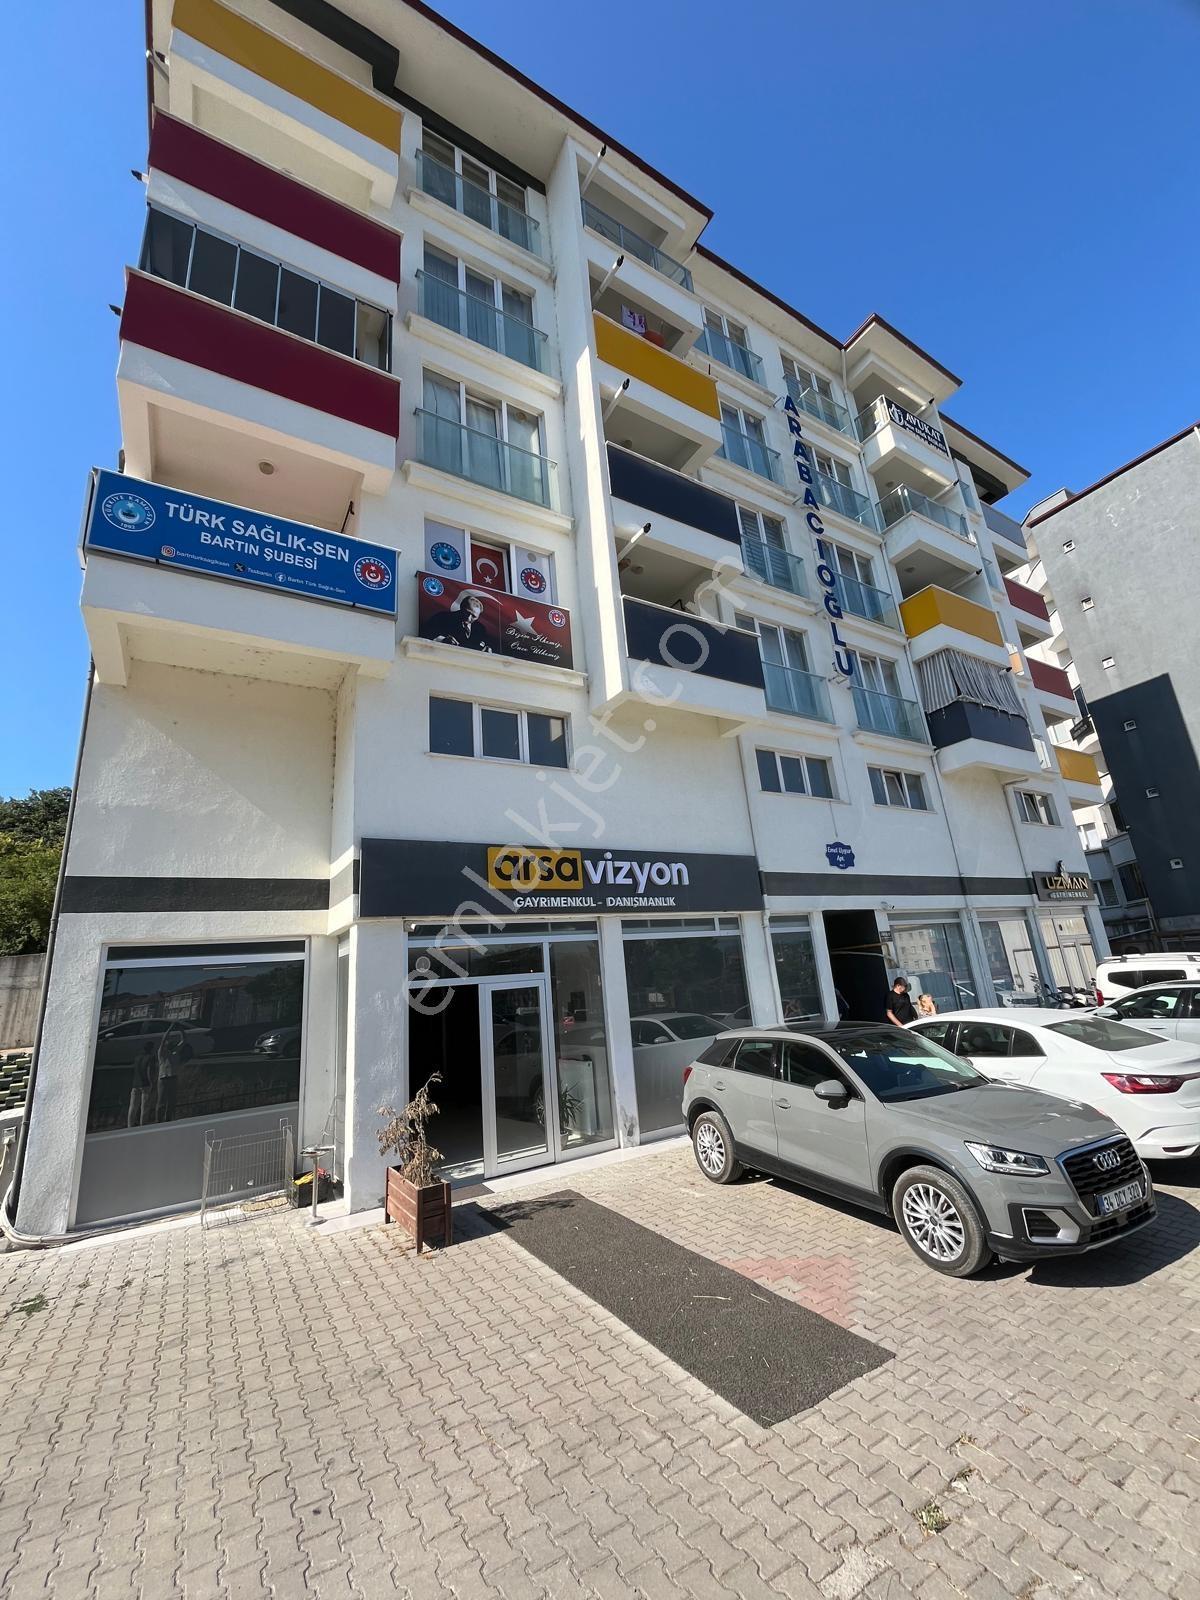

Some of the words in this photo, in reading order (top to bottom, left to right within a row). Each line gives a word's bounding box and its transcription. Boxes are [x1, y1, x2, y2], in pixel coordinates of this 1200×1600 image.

[906, 413, 941, 442] AVUKAT
[165, 501, 225, 531] TÜRK
[231, 521, 349, 562] SAĞLIK-SEN
[784, 395, 853, 677] ARABACIOĞLU
[200, 532, 259, 557] BARTIN
[263, 547, 318, 571] ŞUBESİ
[493, 852, 579, 884] arsa
[584, 851, 690, 893] vizyon
[1045, 876, 1089, 890] UZMAN
[606, 896, 676, 908] DANIŞMANLIK
[1103, 1195, 1115, 1212] 34
